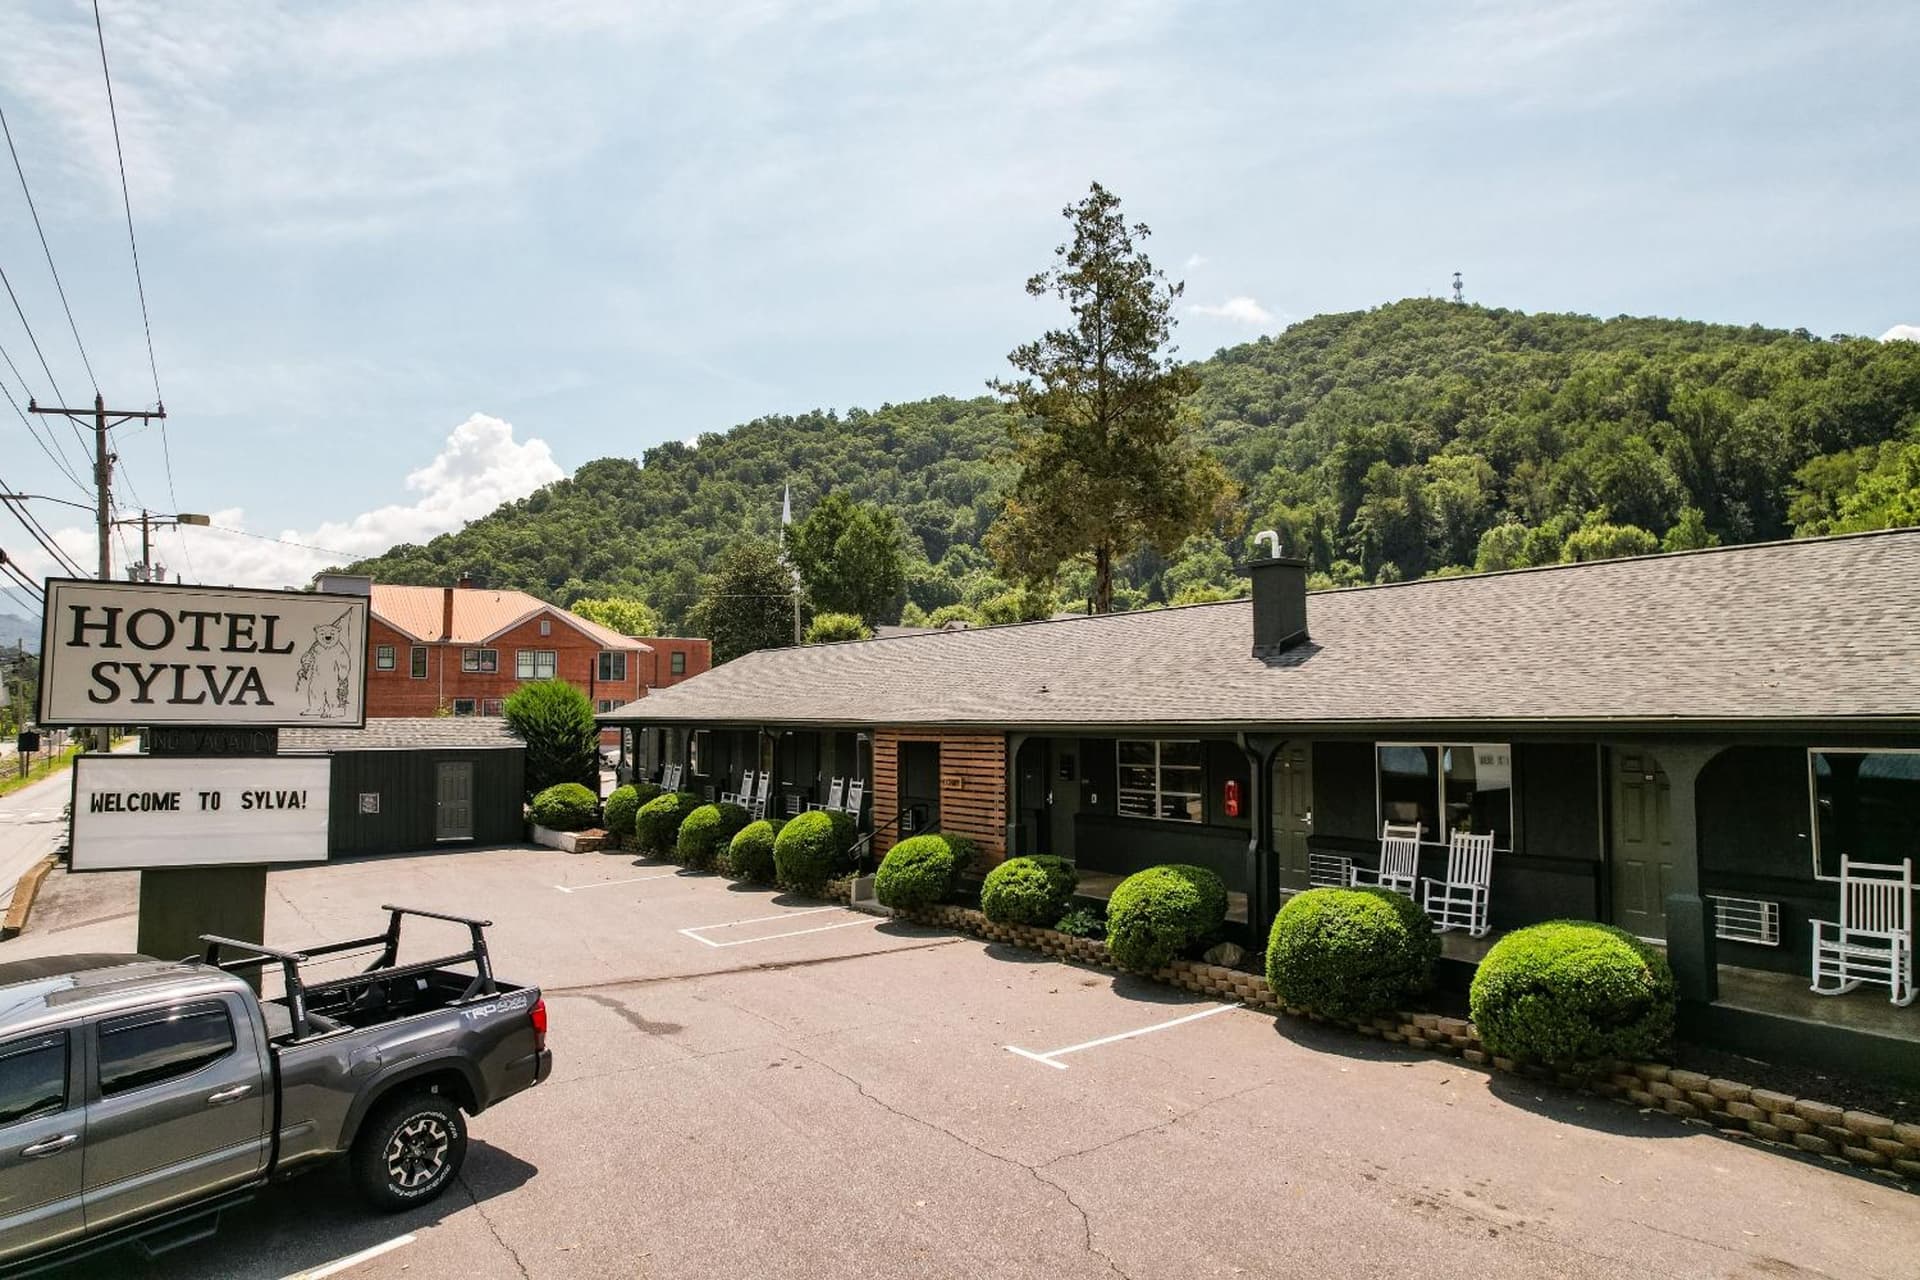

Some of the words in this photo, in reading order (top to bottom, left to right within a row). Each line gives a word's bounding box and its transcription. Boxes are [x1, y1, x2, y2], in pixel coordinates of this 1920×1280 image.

[66, 605, 294, 655] HOTEL
[88, 661, 274, 706] SYLVA
[192, 729, 275, 753] VACANCY
[90, 792, 180, 813] WELCOME
[199, 791, 220, 810] TO
[241, 790, 306, 810] SYLVA!
[460, 1004, 496, 1019] TRD
